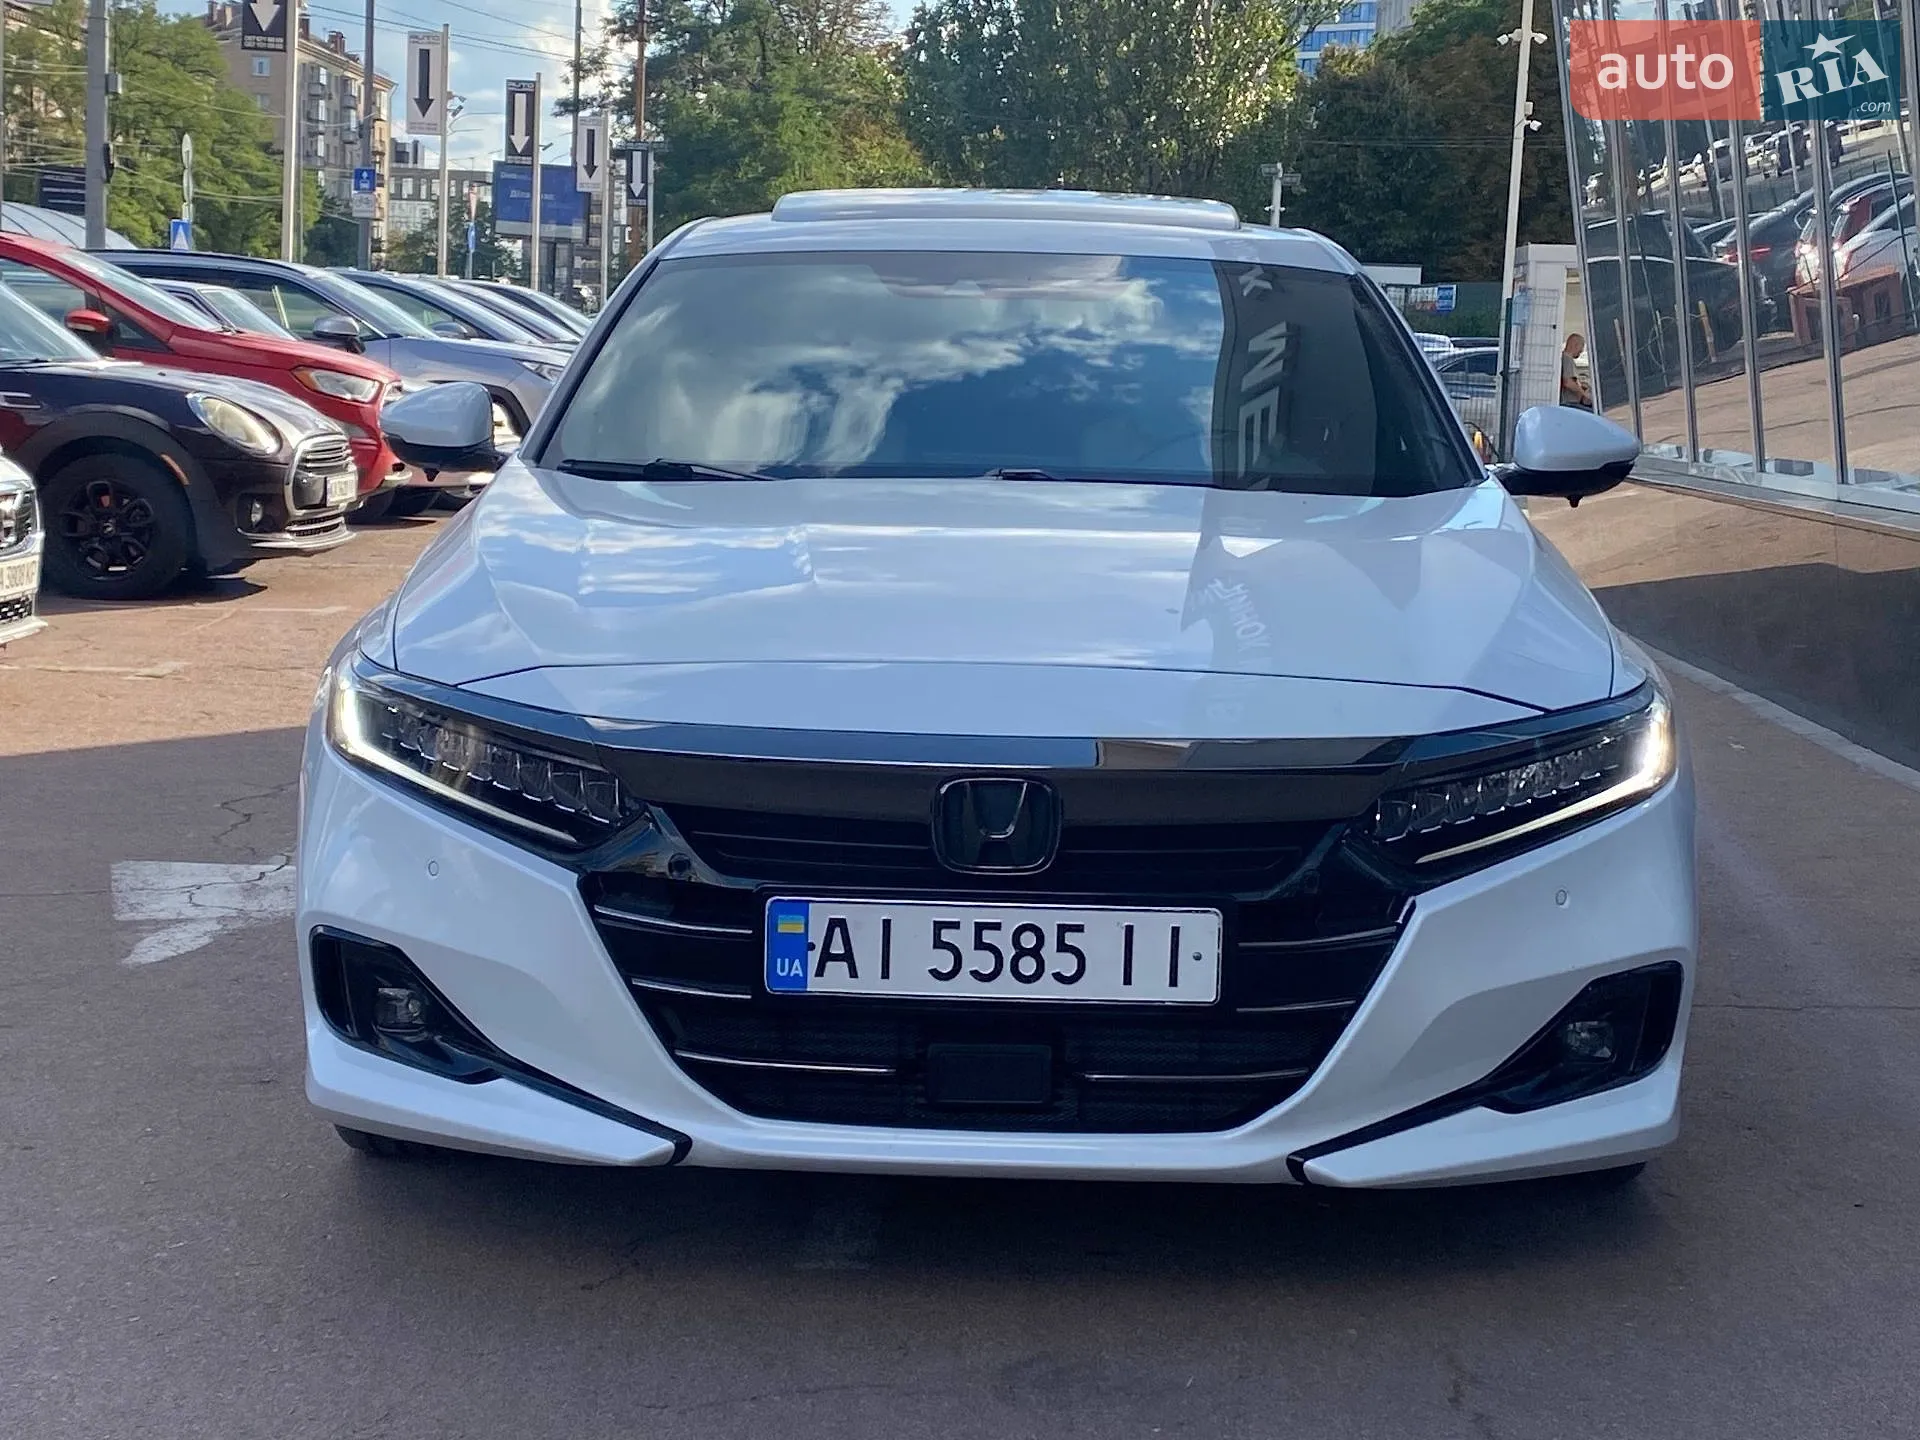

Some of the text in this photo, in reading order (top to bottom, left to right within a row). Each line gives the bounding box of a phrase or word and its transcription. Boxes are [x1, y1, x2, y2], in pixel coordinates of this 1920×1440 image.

[776, 957, 804, 977] UA
[813, 917, 1181, 988] AI 5585 II
